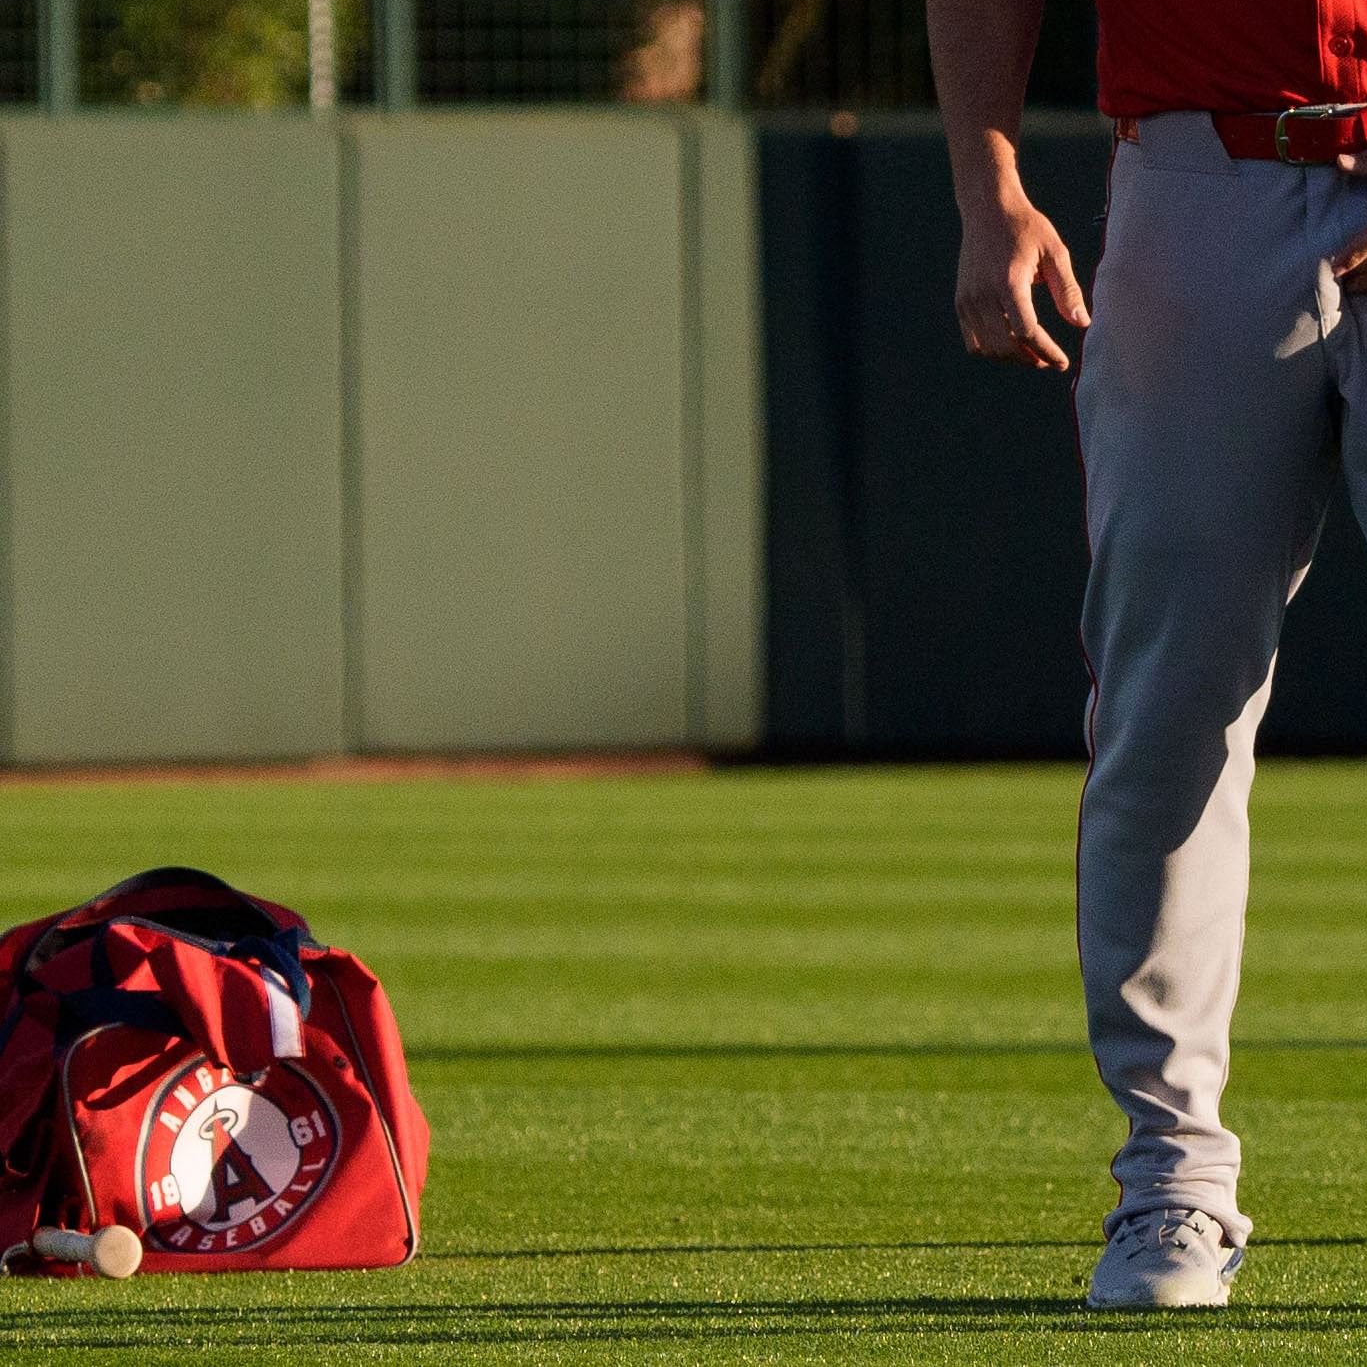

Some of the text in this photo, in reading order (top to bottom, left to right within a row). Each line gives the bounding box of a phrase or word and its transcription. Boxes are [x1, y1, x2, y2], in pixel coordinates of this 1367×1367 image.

[199, 1097, 277, 1224] A
[290, 1110, 326, 1147] 61
[150, 1173, 182, 1212] 19
[168, 1157, 327, 1250] ASEBALL
